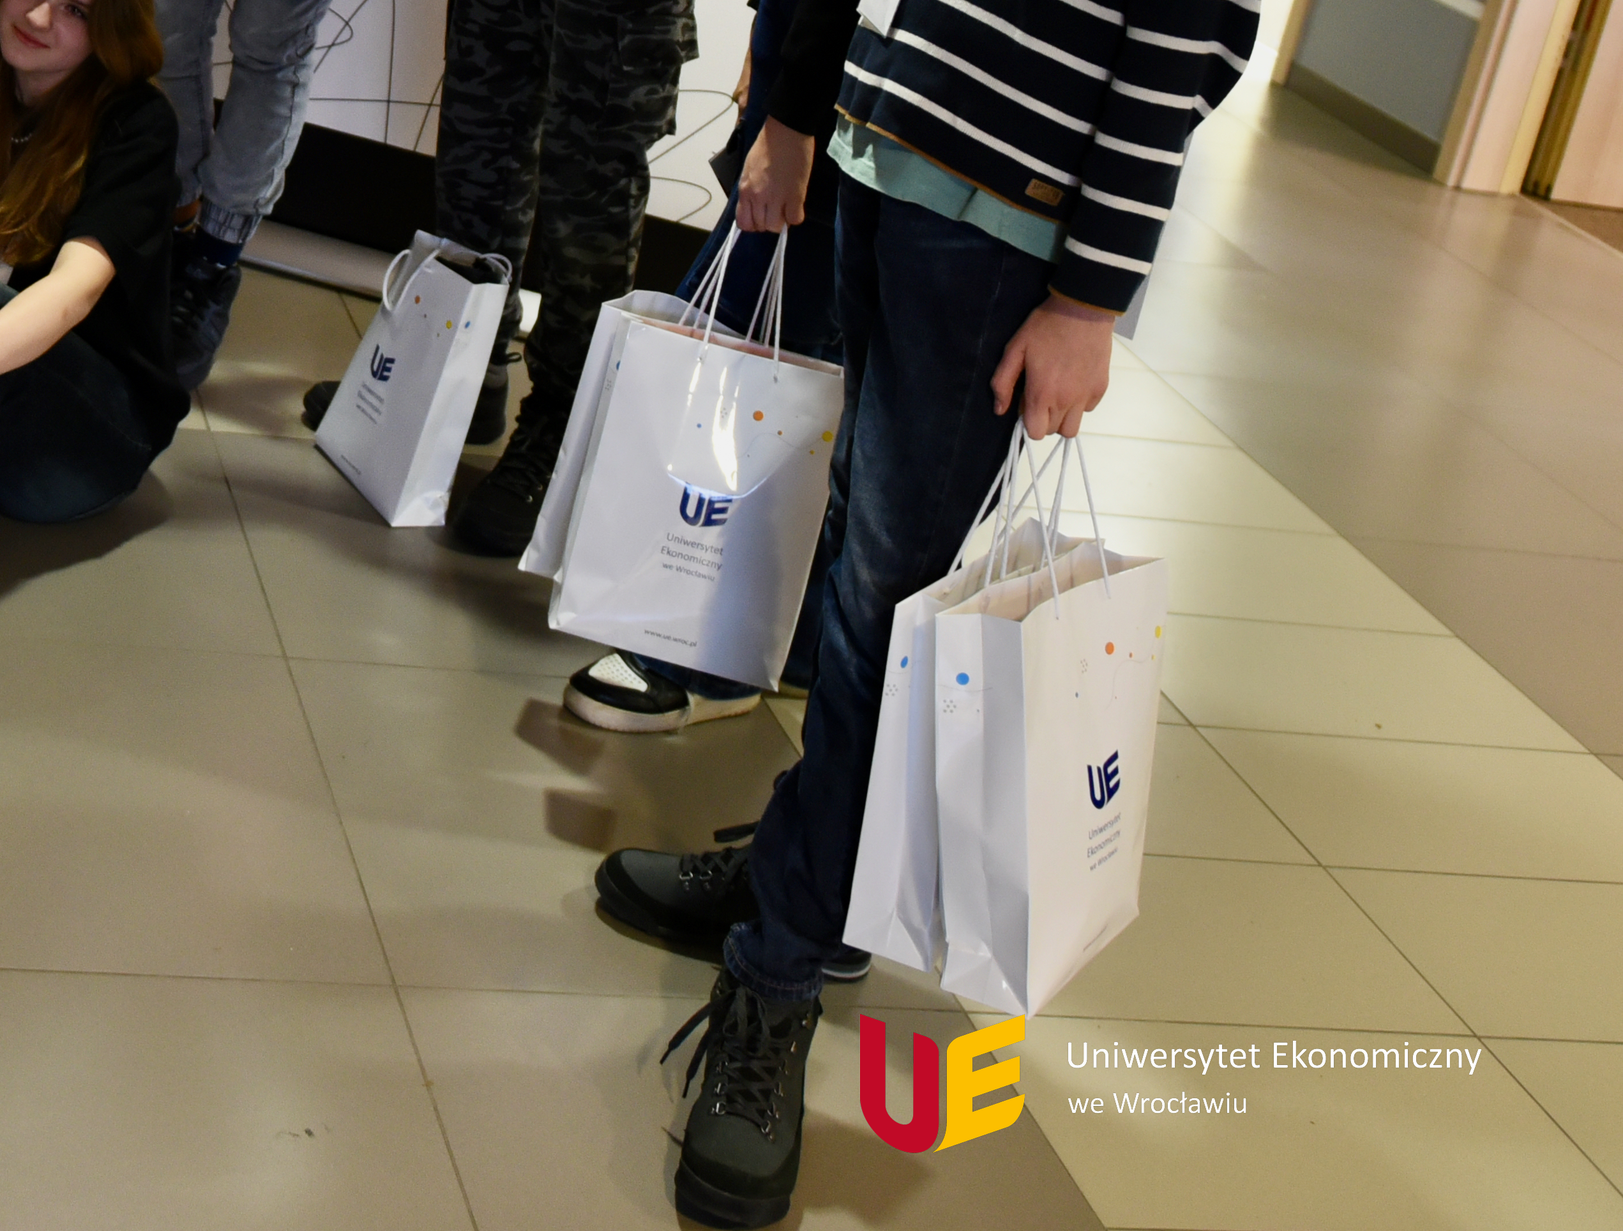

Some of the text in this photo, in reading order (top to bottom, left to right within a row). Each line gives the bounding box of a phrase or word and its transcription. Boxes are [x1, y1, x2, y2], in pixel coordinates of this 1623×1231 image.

[370, 344, 396, 382] UE
[679, 481, 733, 528] UE
[660, 545, 723, 572] Ekonomiczny
[666, 532, 724, 556] Uniwersytet
[662, 562, 716, 583] we Wrocławiu
[644, 628, 698, 648] www.ue.wroc.pl
[1086, 749, 1121, 810] UE
[1088, 812, 1122, 841] Uniwersytet
[1086, 830, 1121, 859] Ekonomiczny
